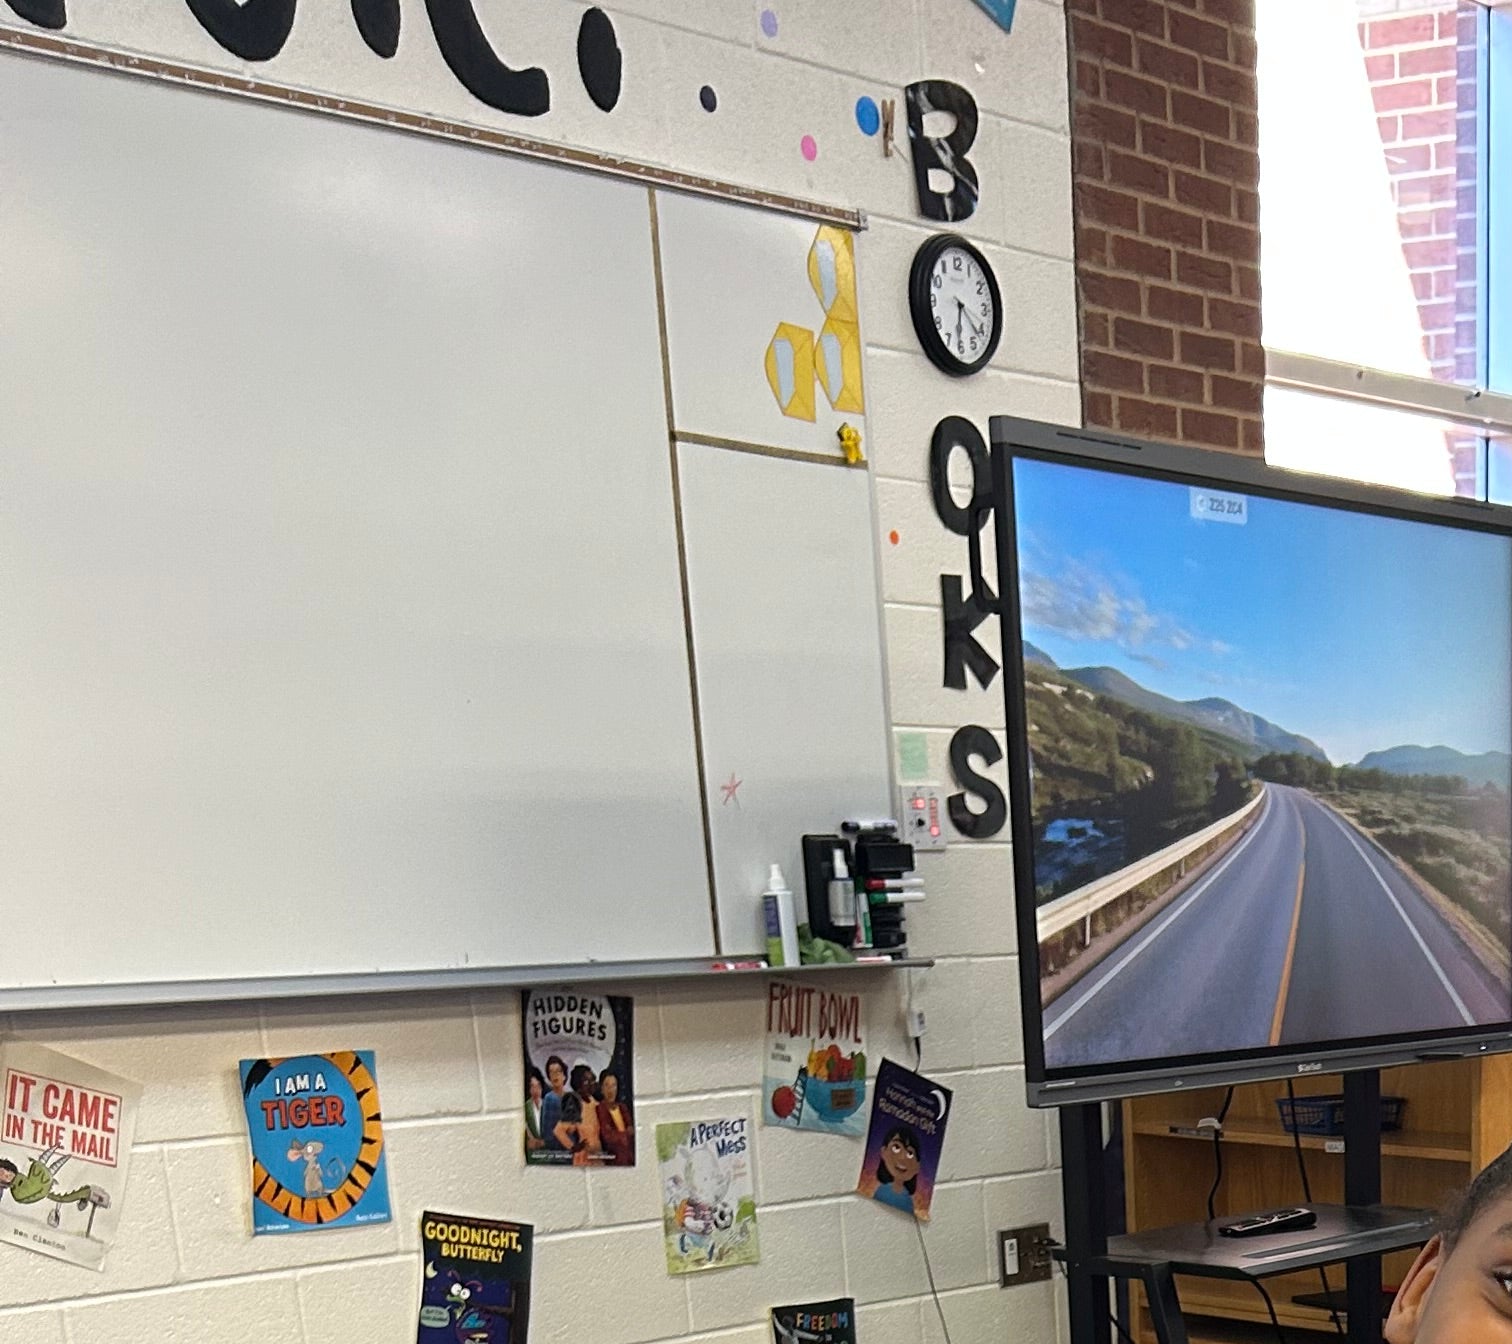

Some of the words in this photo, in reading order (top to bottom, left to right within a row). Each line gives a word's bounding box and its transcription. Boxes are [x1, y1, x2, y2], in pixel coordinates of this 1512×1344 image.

[533, 996, 603, 1019] HIDDEN
[768, 981, 815, 1038] FRUIT
[819, 991, 862, 1044] BOWL
[532, 1017, 607, 1041] FIGURES
[275, 1077, 281, 1095] I
[285, 1074, 310, 1095] AM
[315, 1073, 327, 1091] A
[9, 1074, 36, 1113] IT
[42, 1083, 117, 1134] CAME
[260, 1096, 346, 1131] TIGER
[6, 1114, 25, 1140] IN
[31, 1119, 65, 1149] THE
[71, 1129, 114, 1161] MAIL
[690, 1127, 698, 1148] A
[698, 1118, 747, 1144] PERFECT
[424, 1220, 523, 1253] GOODNIGHT,
[440, 1242, 505, 1264] BUTTERFLY
[795, 1311, 849, 1332] FREEDOM
